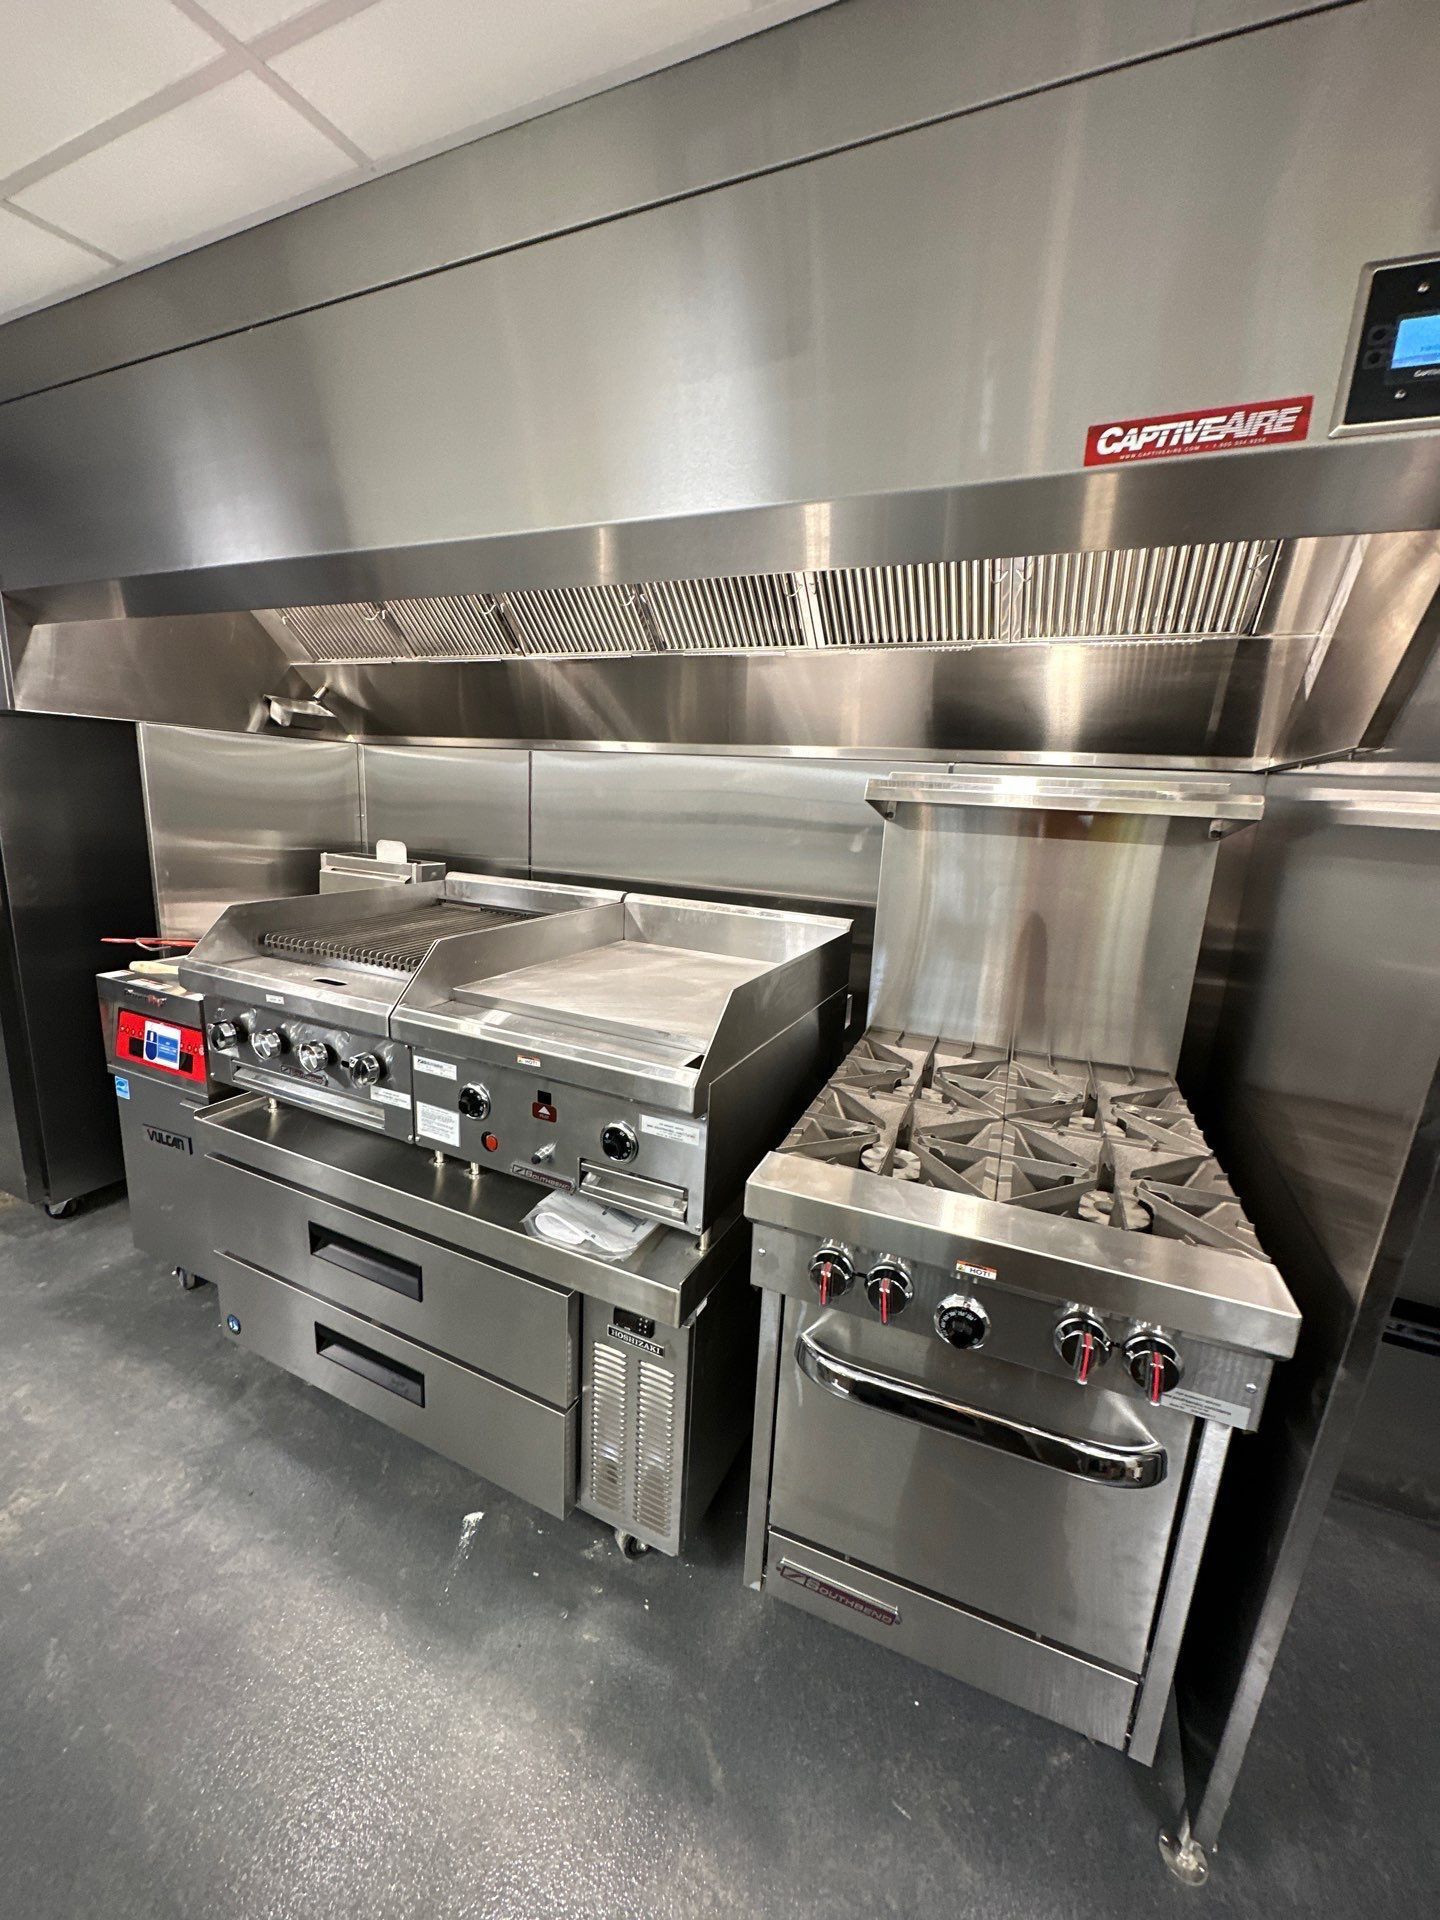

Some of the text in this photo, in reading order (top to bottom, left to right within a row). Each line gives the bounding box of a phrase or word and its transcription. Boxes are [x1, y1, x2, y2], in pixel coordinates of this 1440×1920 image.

[1096, 406, 1304, 455] CAPTIVEAIRE
[147, 1129, 185, 1151] VULCAN
[969, 1267, 991, 1278] HOT!
[611, 1329, 661, 1354] HOSHIZAKI
[805, 1578, 893, 1624] SOUTHBEND
